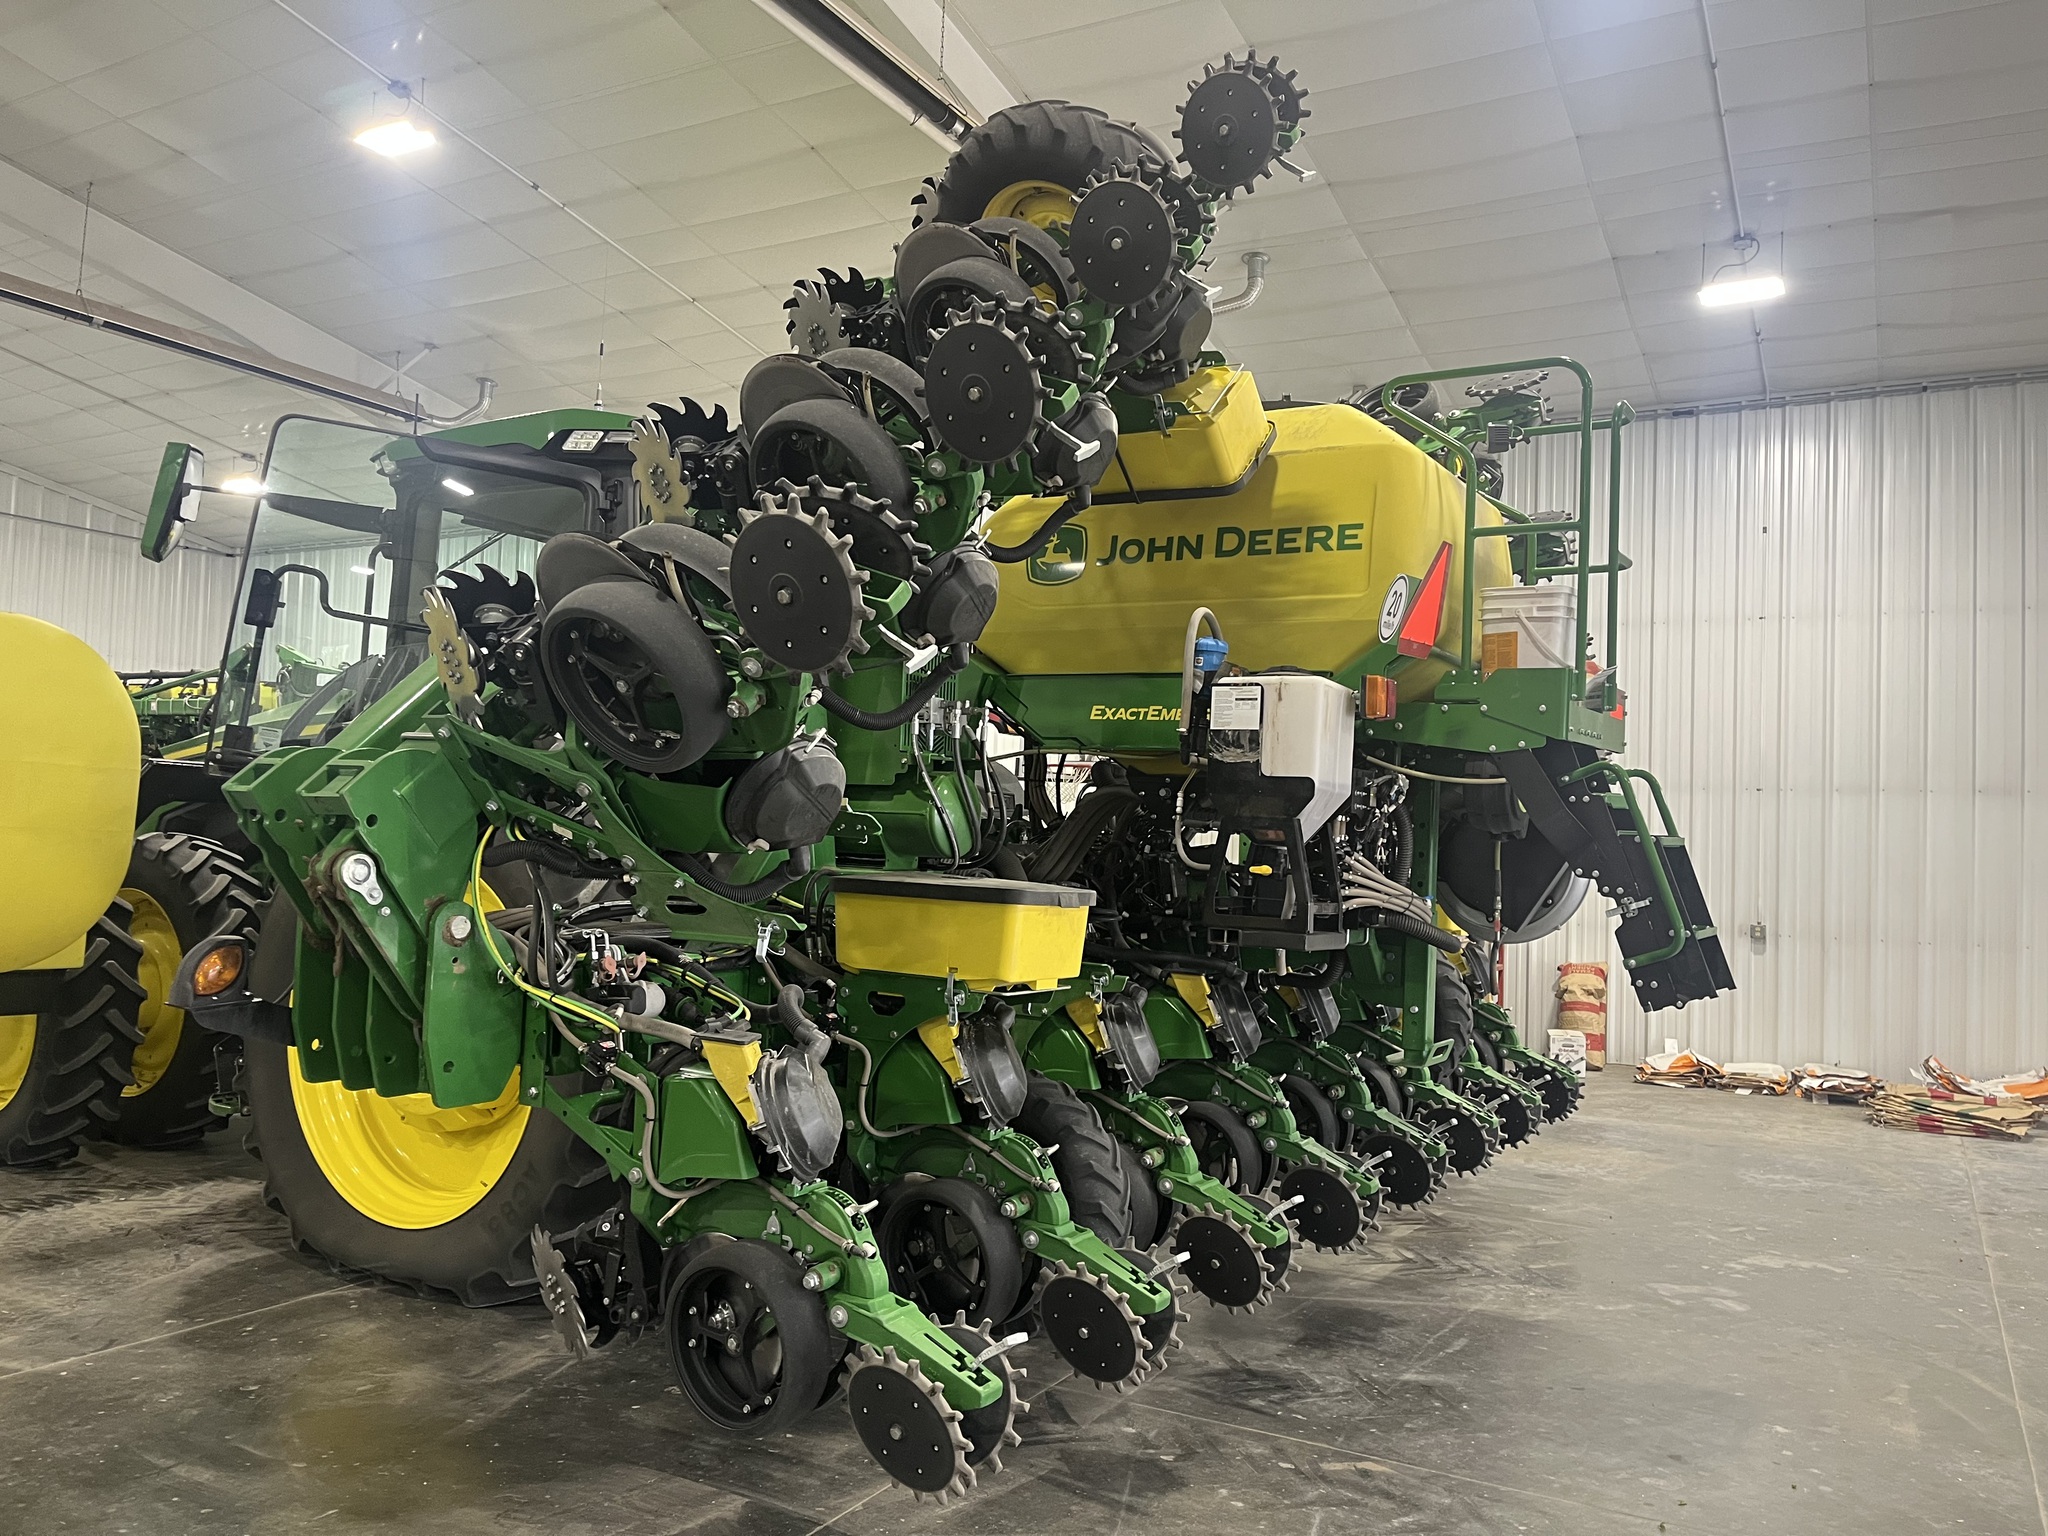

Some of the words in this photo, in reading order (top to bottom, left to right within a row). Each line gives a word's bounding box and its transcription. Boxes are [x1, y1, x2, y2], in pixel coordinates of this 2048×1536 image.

[1096, 534, 1204, 567] JOHN
[1215, 523, 1364, 558] DEERE
[1386, 590, 1403, 619] 20
[1089, 705, 1211, 721] EXACTEME
